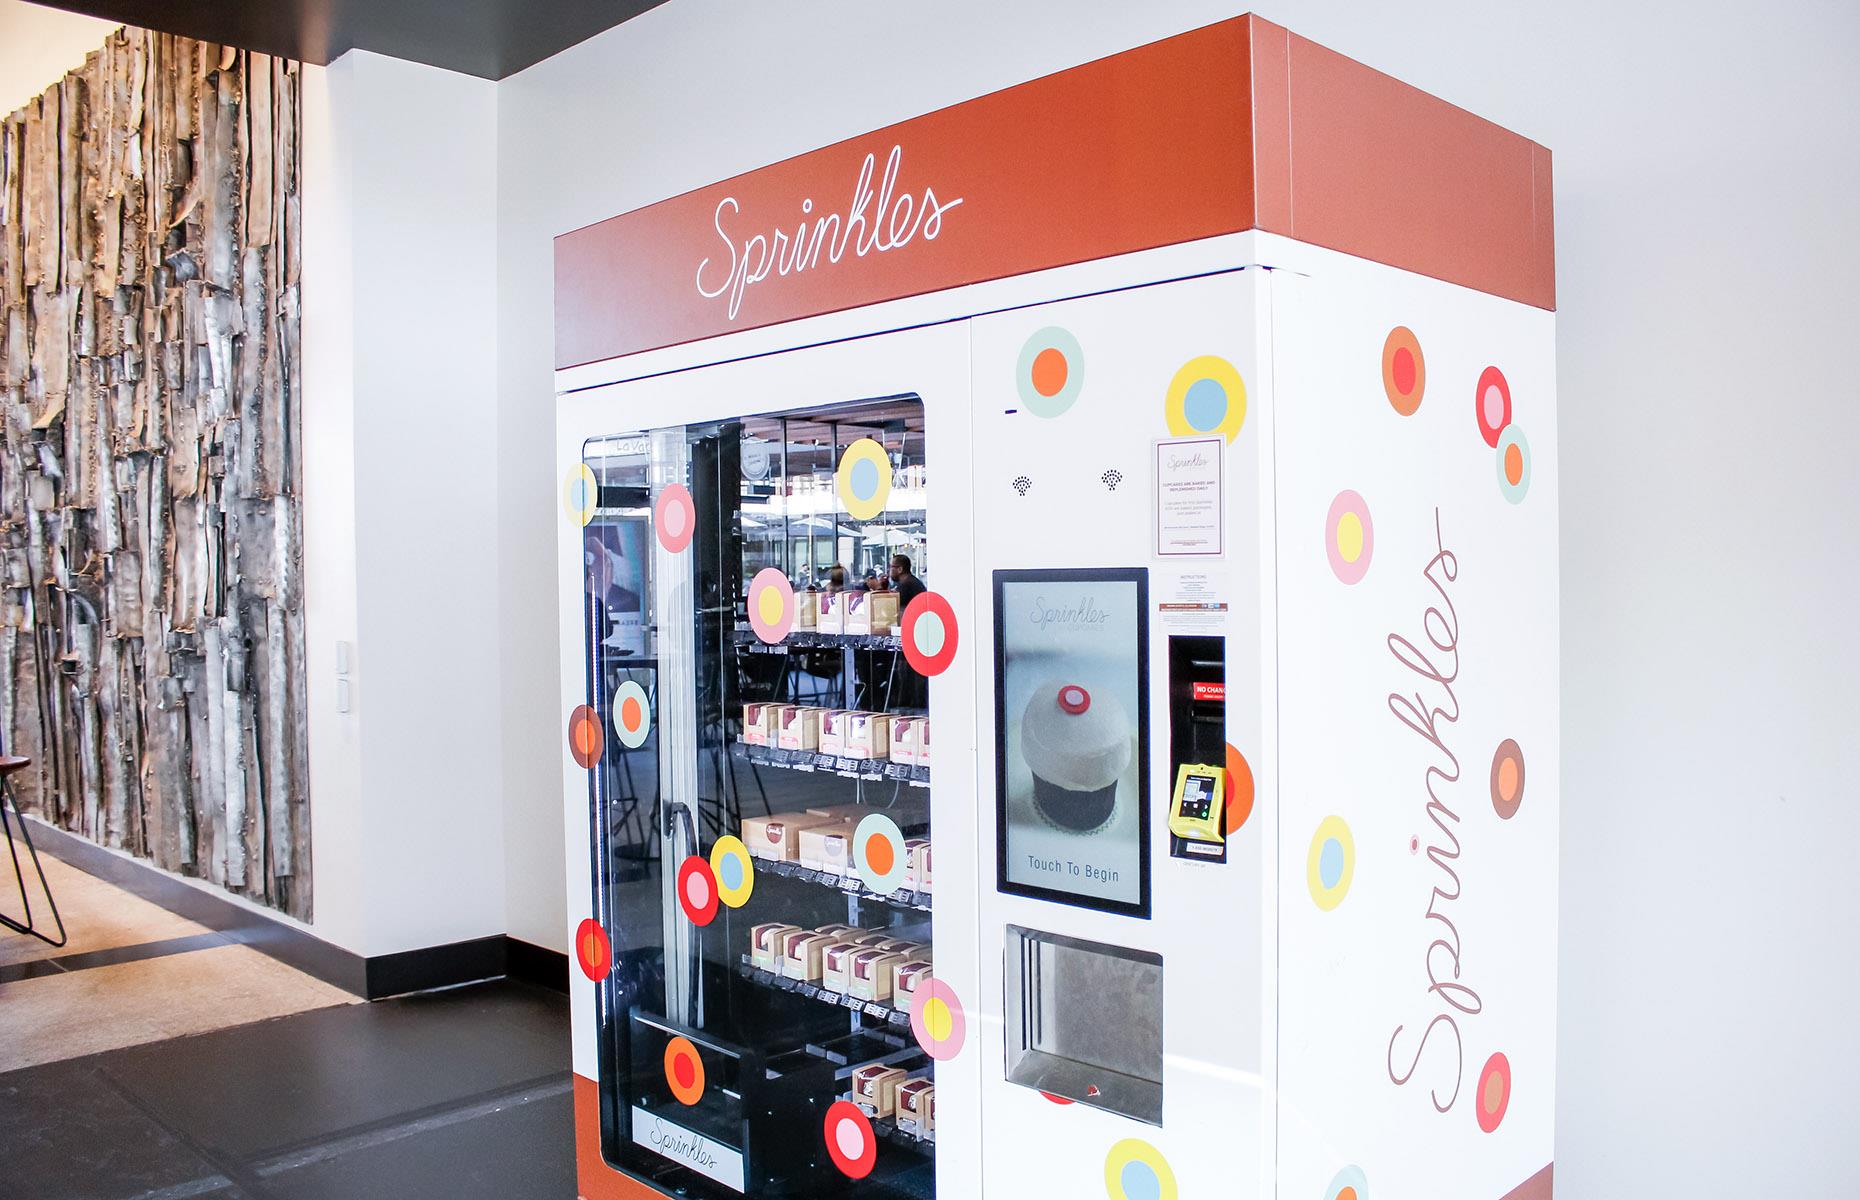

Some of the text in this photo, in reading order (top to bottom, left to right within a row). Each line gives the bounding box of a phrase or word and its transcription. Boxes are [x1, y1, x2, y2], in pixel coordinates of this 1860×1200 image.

[696, 144, 964, 321] Sprinkles
[1030, 596, 1111, 632] Sprinkles
[1387, 507, 1482, 1114] Sprinkles
[1027, 855, 1119, 883] Touch To Begin
[650, 1117, 718, 1169] Sprinkles
